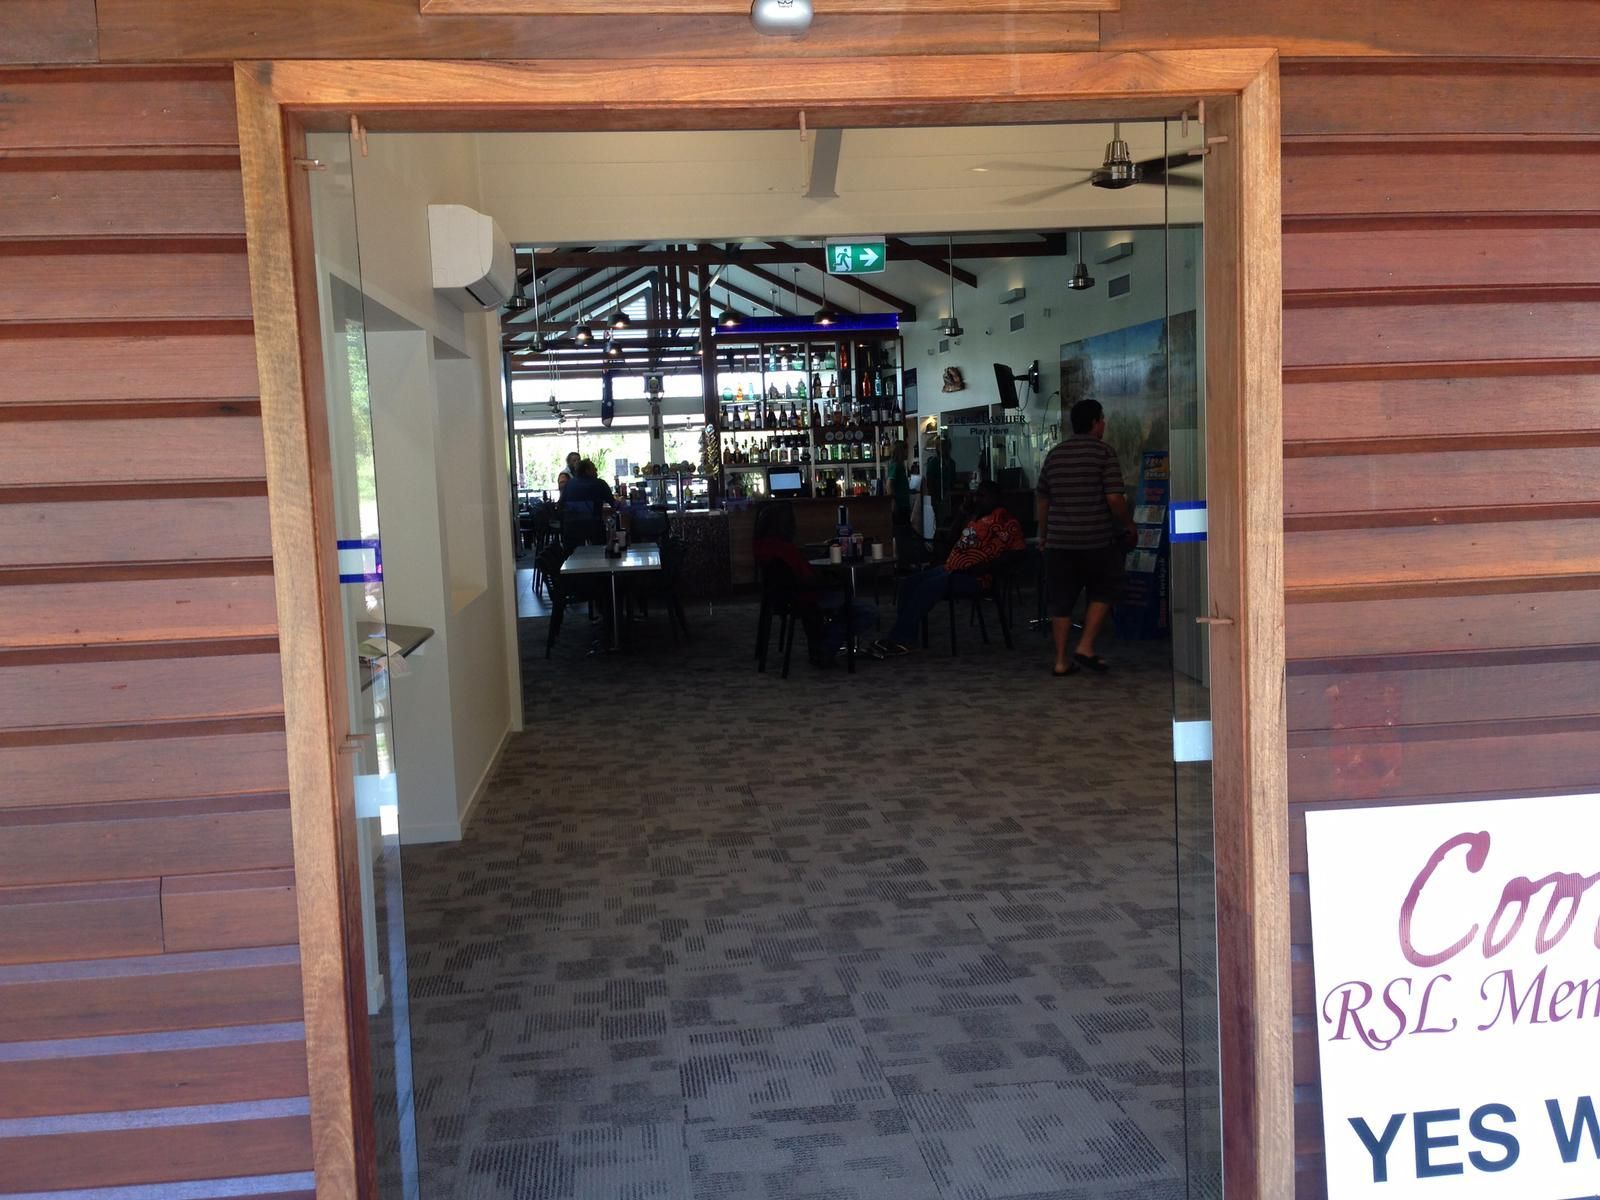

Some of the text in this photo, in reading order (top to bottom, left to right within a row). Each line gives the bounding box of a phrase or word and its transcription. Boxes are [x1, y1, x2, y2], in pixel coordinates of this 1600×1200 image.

[970, 427, 986, 436] Play
[1399, 830, 1600, 968] Coo
[1323, 973, 1458, 1051] RSL
[1347, 1103, 1520, 1183] YES
